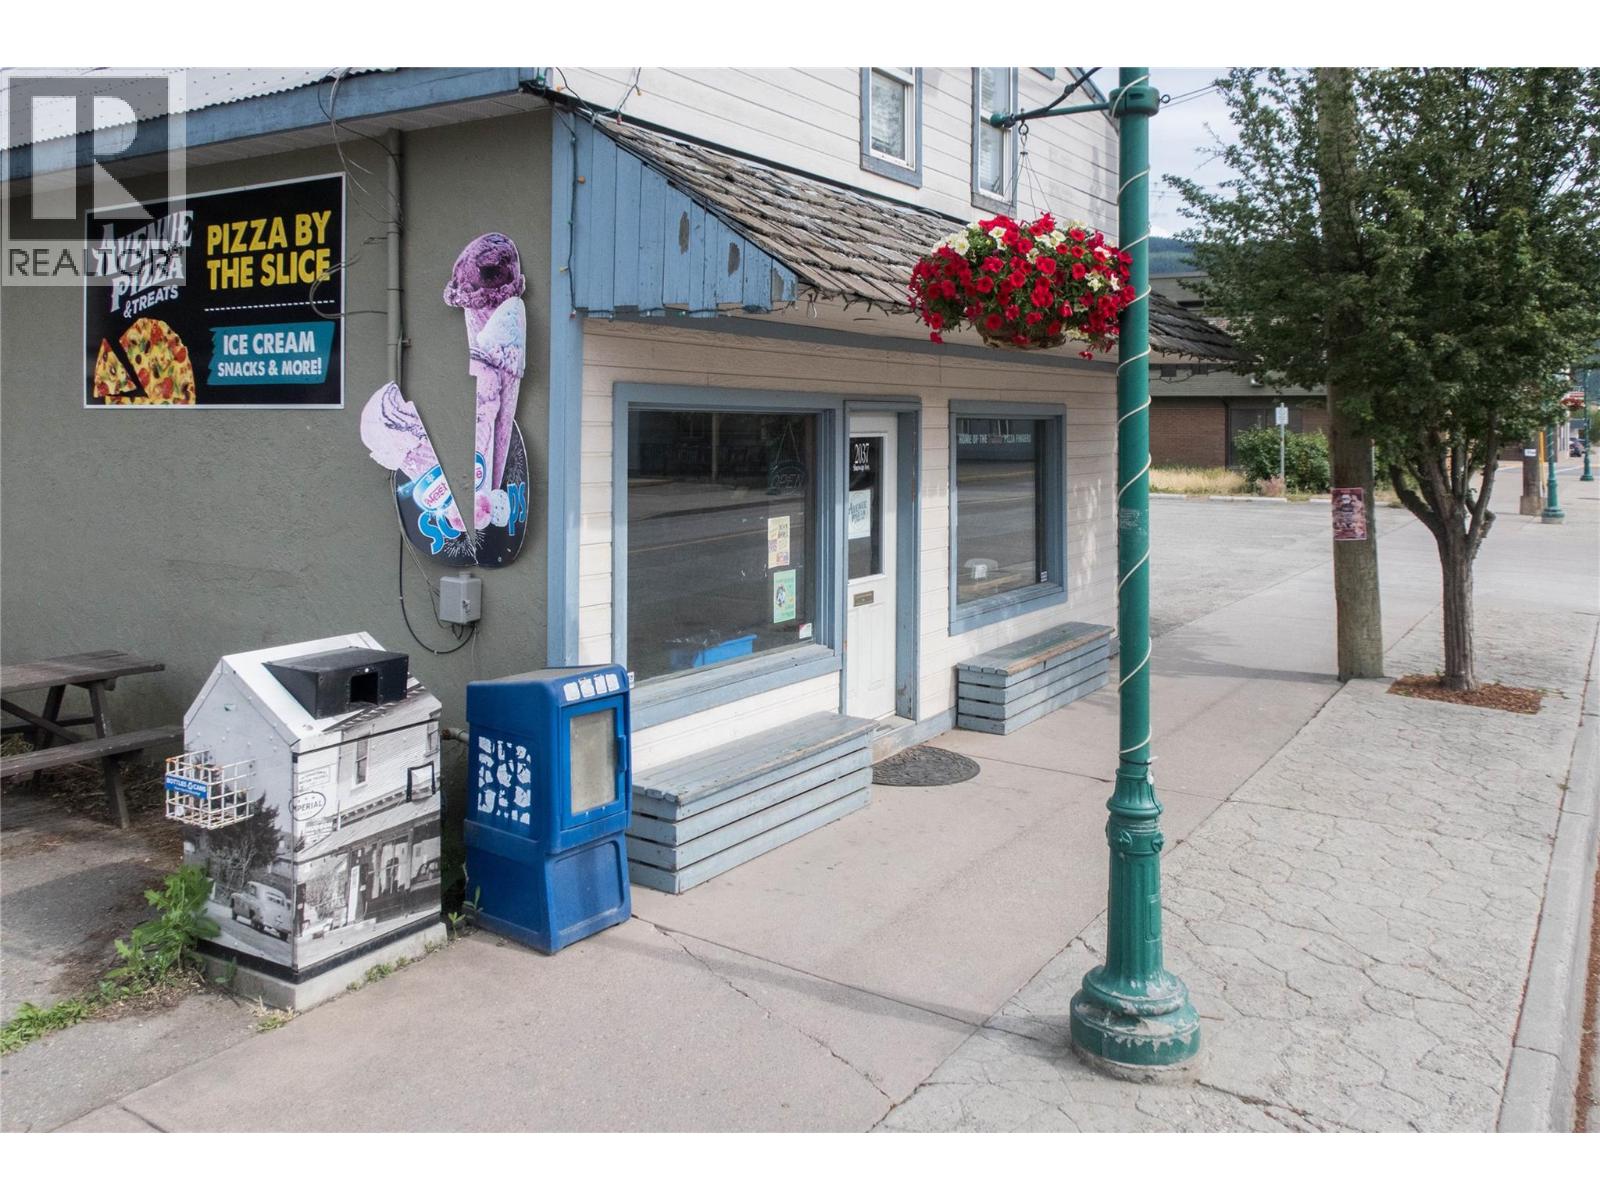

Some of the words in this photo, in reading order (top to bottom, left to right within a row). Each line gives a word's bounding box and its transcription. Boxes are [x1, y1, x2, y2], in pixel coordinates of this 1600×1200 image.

[92, 210, 194, 276] AVENUE
[207, 216, 288, 255] PIZZA
[295, 210, 331, 246] BY
[110, 252, 185, 313] PIZZA
[207, 256, 253, 290] THE
[260, 248, 330, 287] SLICE
[223, 334, 248, 355] ICE
[252, 331, 315, 354] CREAM
[217, 361, 265, 377] SNACKS
[268, 359, 279, 376] &
[281, 357, 322, 376] MORE!
[854, 443, 870, 464] 2037
